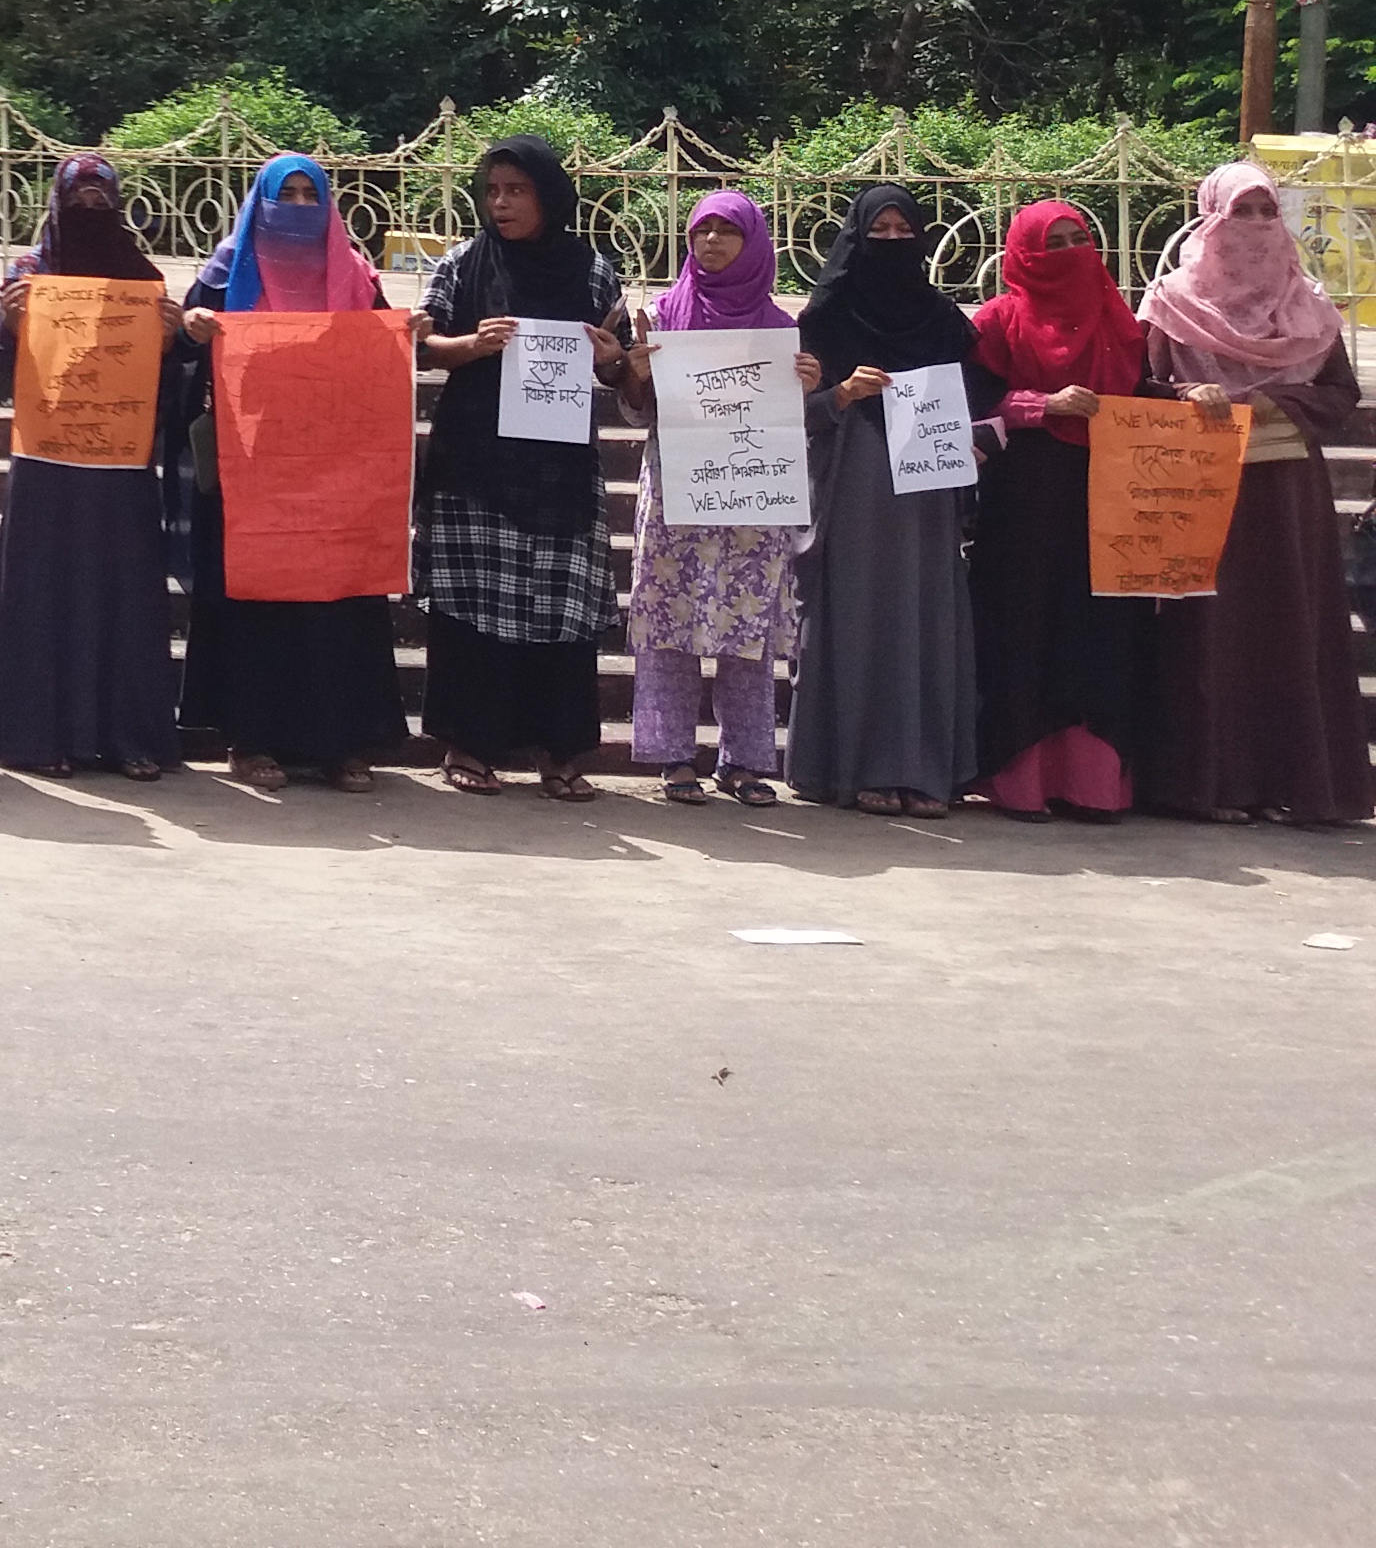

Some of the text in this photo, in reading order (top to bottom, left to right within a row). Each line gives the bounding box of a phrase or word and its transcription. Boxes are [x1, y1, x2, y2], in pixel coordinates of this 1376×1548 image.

[514, 334, 581, 354] আবরার
[528, 360, 568, 388] হত্যার
[521, 380, 557, 404] বিচার
[891, 384, 916, 398] WE
[913, 399, 941, 415] WANT
[1113, 410, 1141, 428] WE
[1146, 412, 1186, 429] WANT
[917, 420, 961, 438] JUSTICE
[934, 439, 959, 453] FOR
[898, 459, 934, 476] ABRAR
[687, 493, 717, 513] WE
[715, 490, 753, 511] WANT
